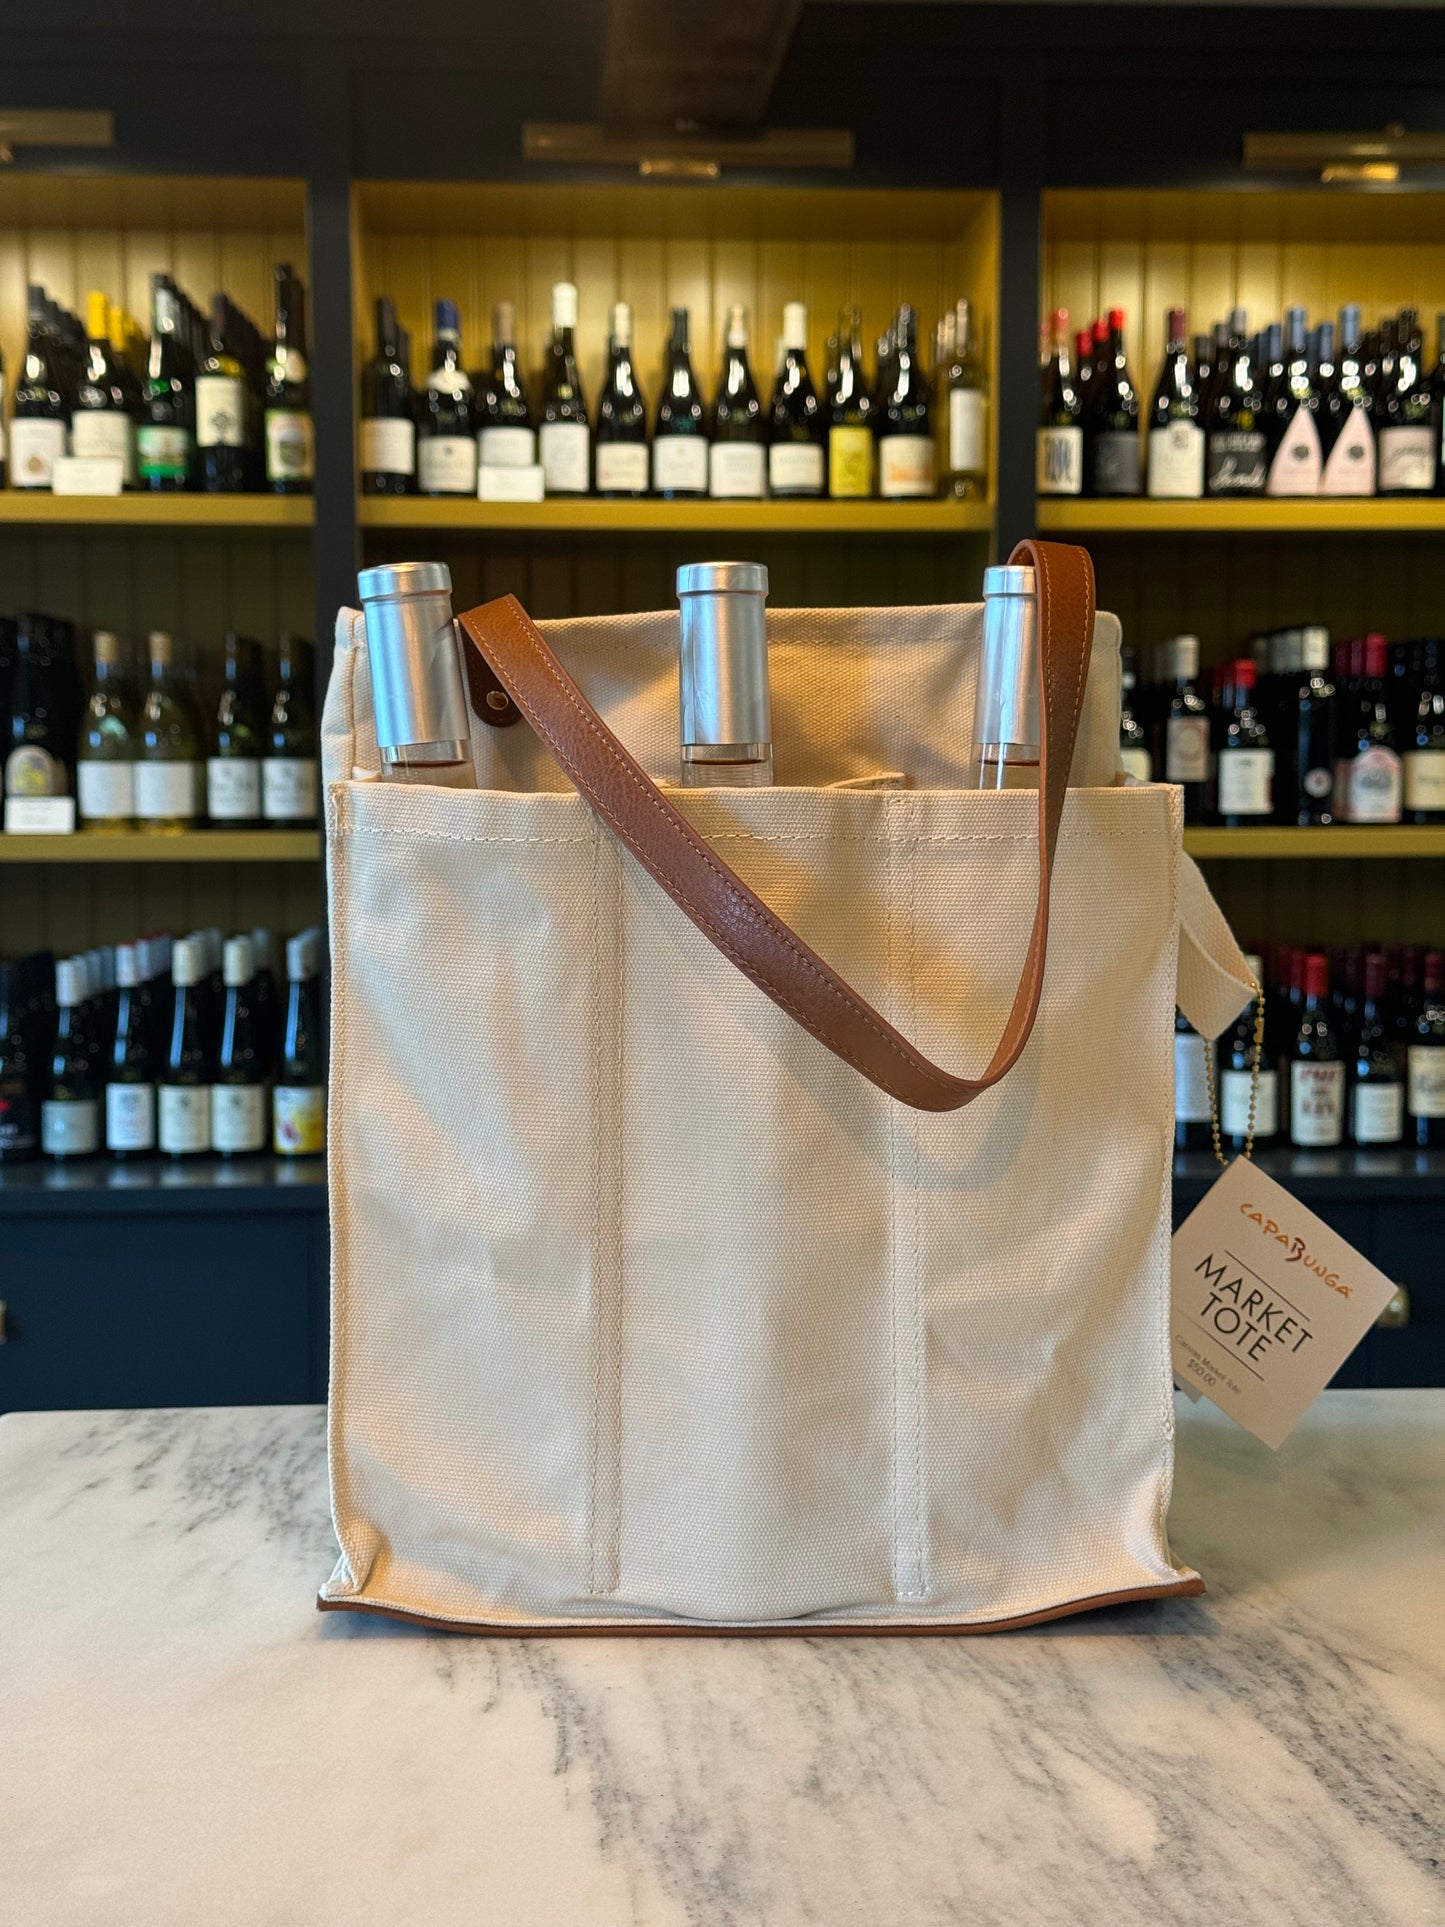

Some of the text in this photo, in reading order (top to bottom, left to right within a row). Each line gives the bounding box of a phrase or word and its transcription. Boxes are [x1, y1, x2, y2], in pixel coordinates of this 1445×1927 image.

[1239, 1202, 1351, 1299] CAPABUNGA
[1194, 1253, 1313, 1353] MARKET
[1200, 1291, 1272, 1362] TOTE
[1187, 1358, 1216, 1387] $50.00
[1201, 1357, 1226, 1381] Market
